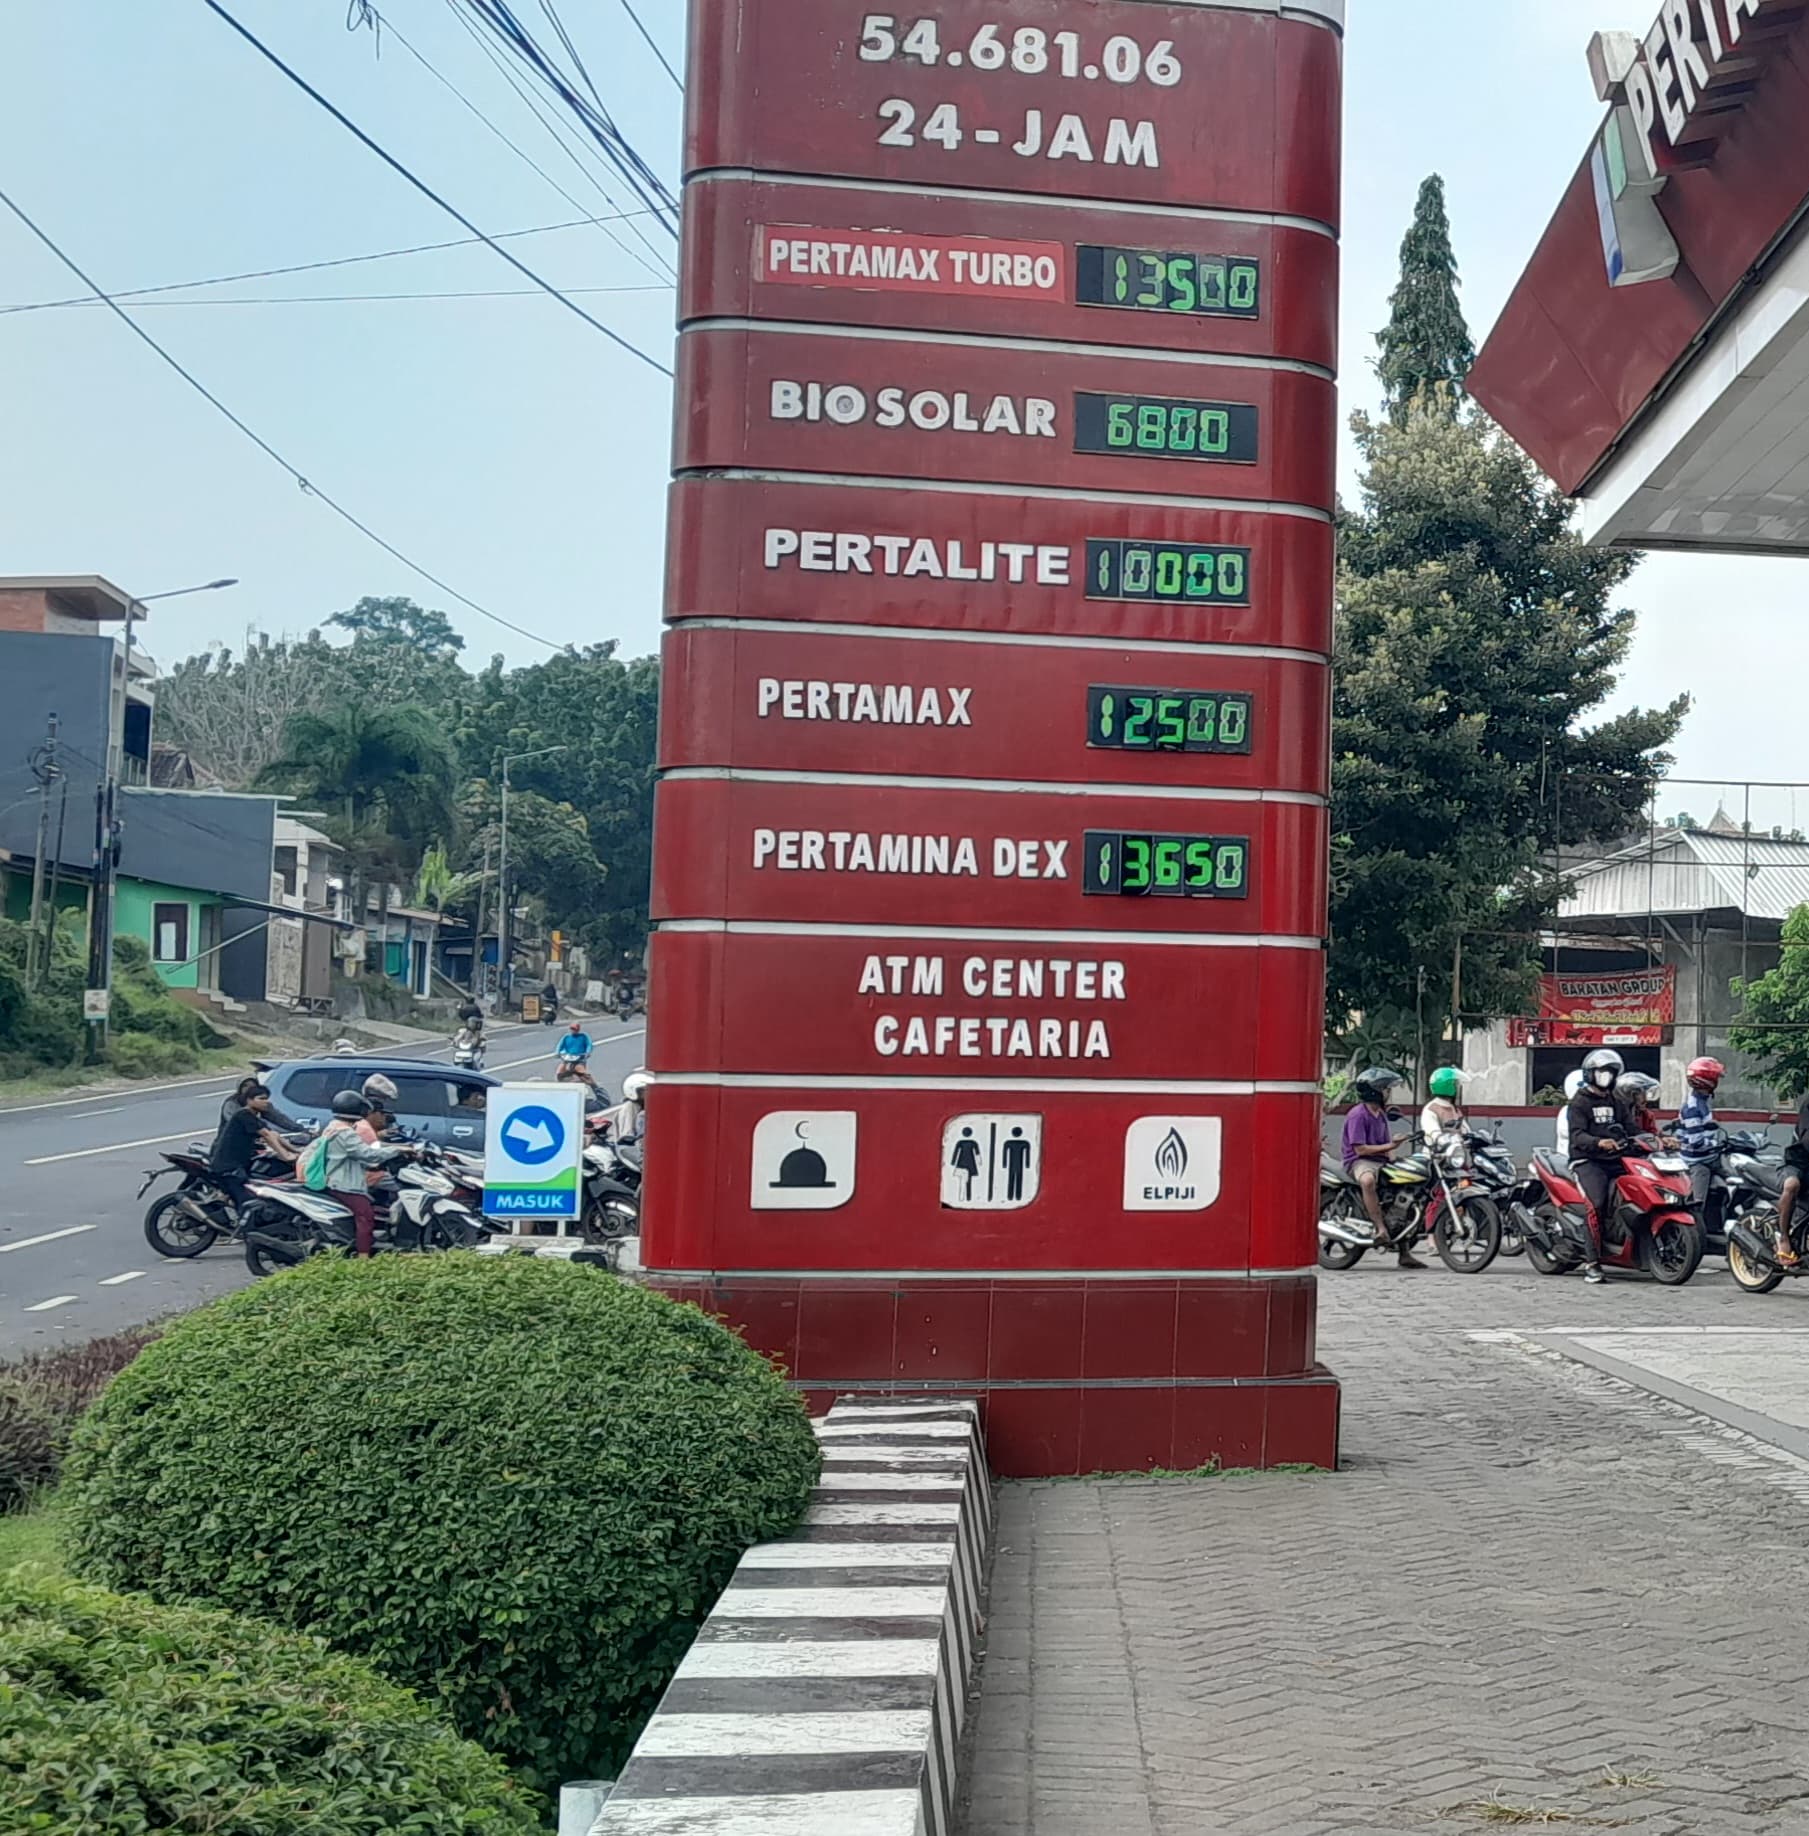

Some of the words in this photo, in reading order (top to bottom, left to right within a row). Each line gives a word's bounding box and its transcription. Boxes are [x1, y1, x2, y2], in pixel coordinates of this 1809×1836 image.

[859, 15, 1182, 86] 54.681.06
[769, 239, 940, 283] PERTAMAX
[948, 250, 1057, 289] TURBO
[1115, 256, 1257, 311] 13500
[1107, 404, 1230, 453] 6800
[763, 528, 1071, 585] PERTALITE
[1098, 548, 1245, 596] 10000
[757, 678, 973, 726] PERTAMAX
[1100, 694, 1246, 745] 12500
[752, 828, 979, 876] PERTAMINA
[992, 837, 1069, 879] DEX
[1099, 840, 1242, 888] 13650
[857, 955, 944, 995] ATM
[962, 956, 1126, 1000] CENTER
[1620, 978, 1665, 995] GROUP
[873, 1014, 1111, 1059] CAFETARIA
[495, 1194, 564, 1209] MASUK
[1143, 1186, 1195, 1200] ELPIJI
